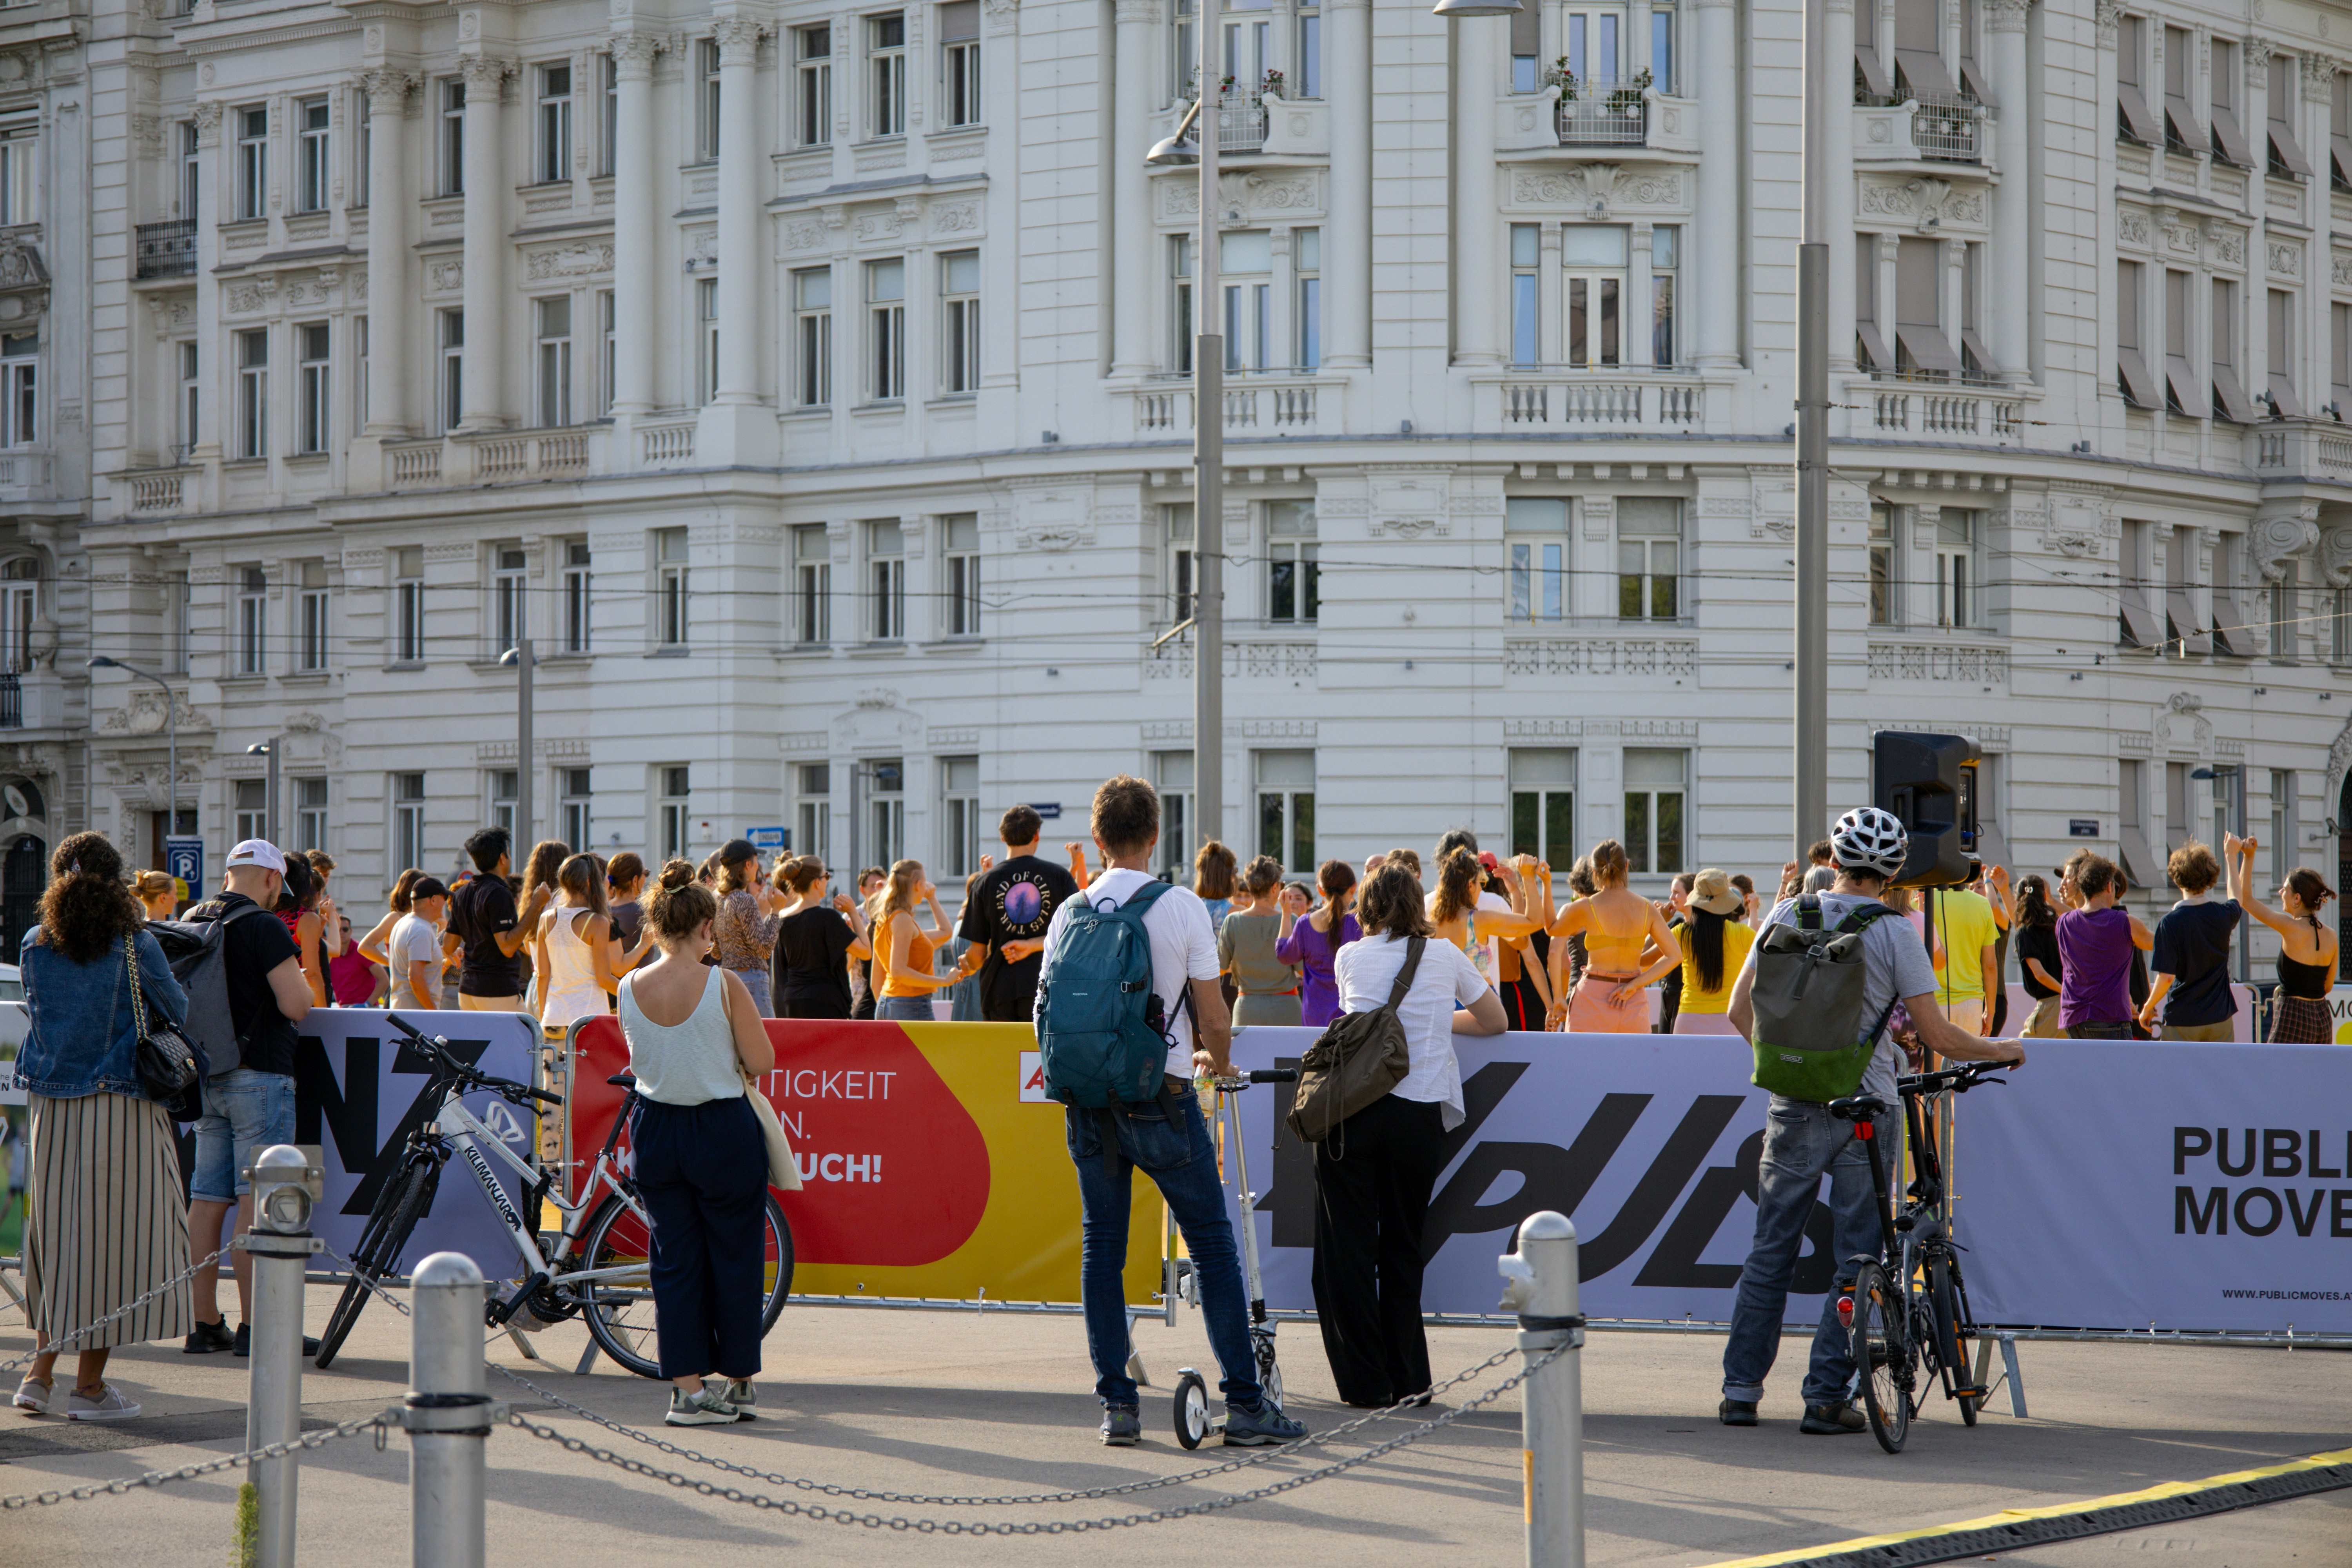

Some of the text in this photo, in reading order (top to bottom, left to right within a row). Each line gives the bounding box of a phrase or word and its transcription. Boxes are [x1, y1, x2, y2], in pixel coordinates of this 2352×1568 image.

[1012, 871, 1030, 882] OF
[795, 1152, 882, 1183] UCH!
[464, 1145, 515, 1224] KILIMANJARO
[2175, 1186, 2352, 1238] MOVE
[2222, 1289, 2352, 1301] WWW.PUBLICMOVES.A
